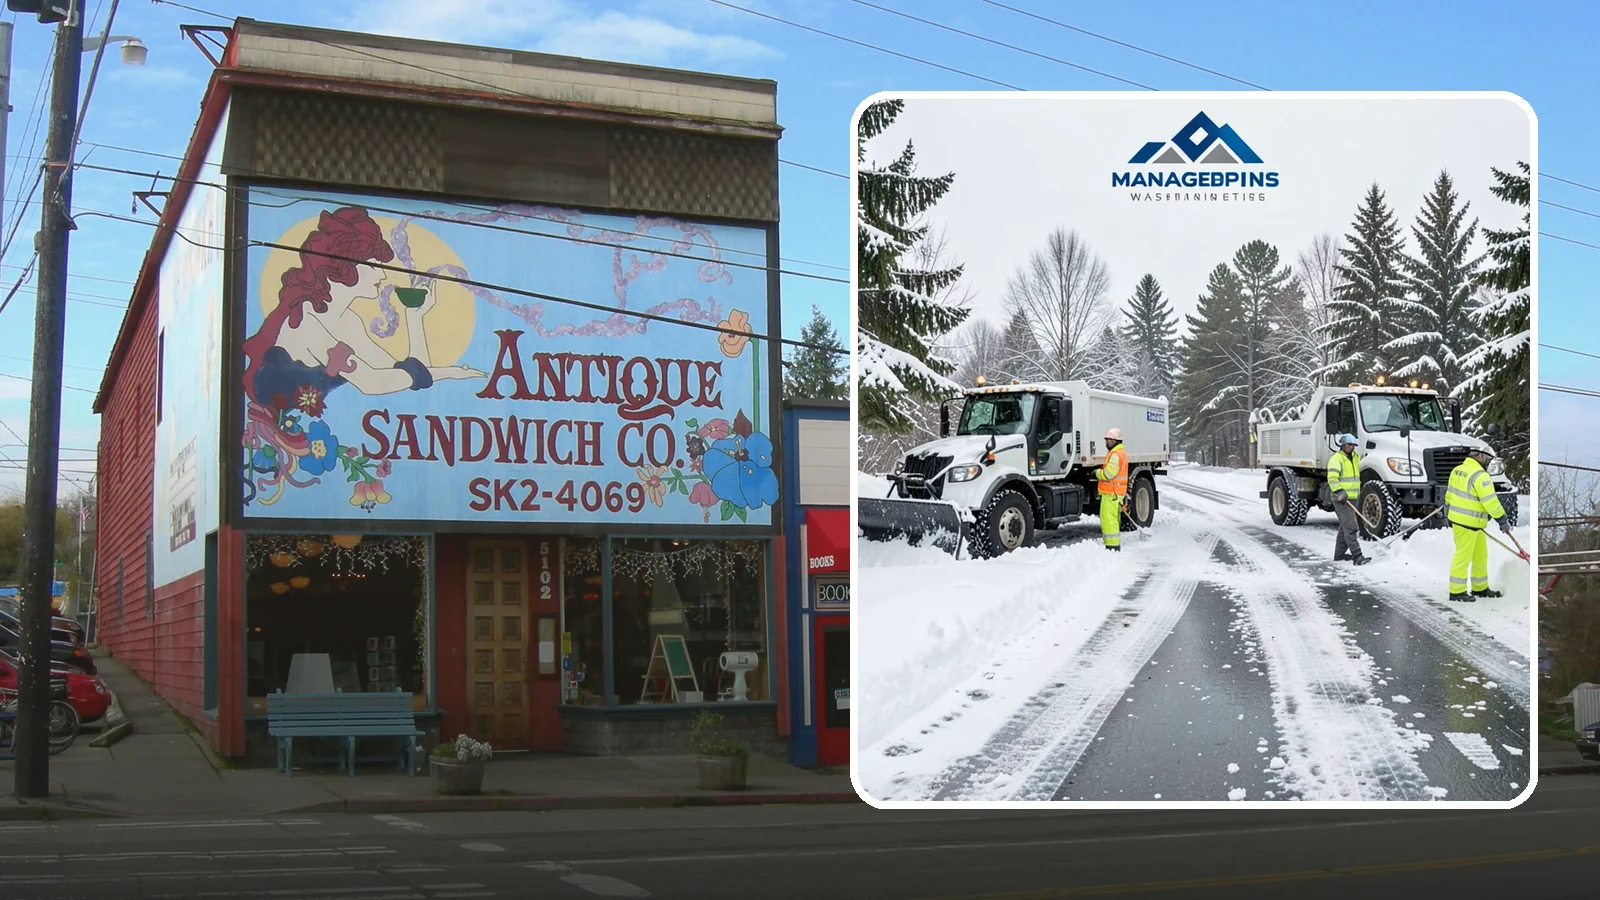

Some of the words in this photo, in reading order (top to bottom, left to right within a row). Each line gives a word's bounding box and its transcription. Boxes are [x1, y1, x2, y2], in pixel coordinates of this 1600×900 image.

[476, 329, 723, 421] ANTIQUE
[361, 409, 604, 467] SANDWICH
[617, 421, 685, 469] CO.
[468, 477, 646, 513] SK2-4069
[540, 541, 551, 600] 5102
[809, 555, 835, 569] BOOKS
